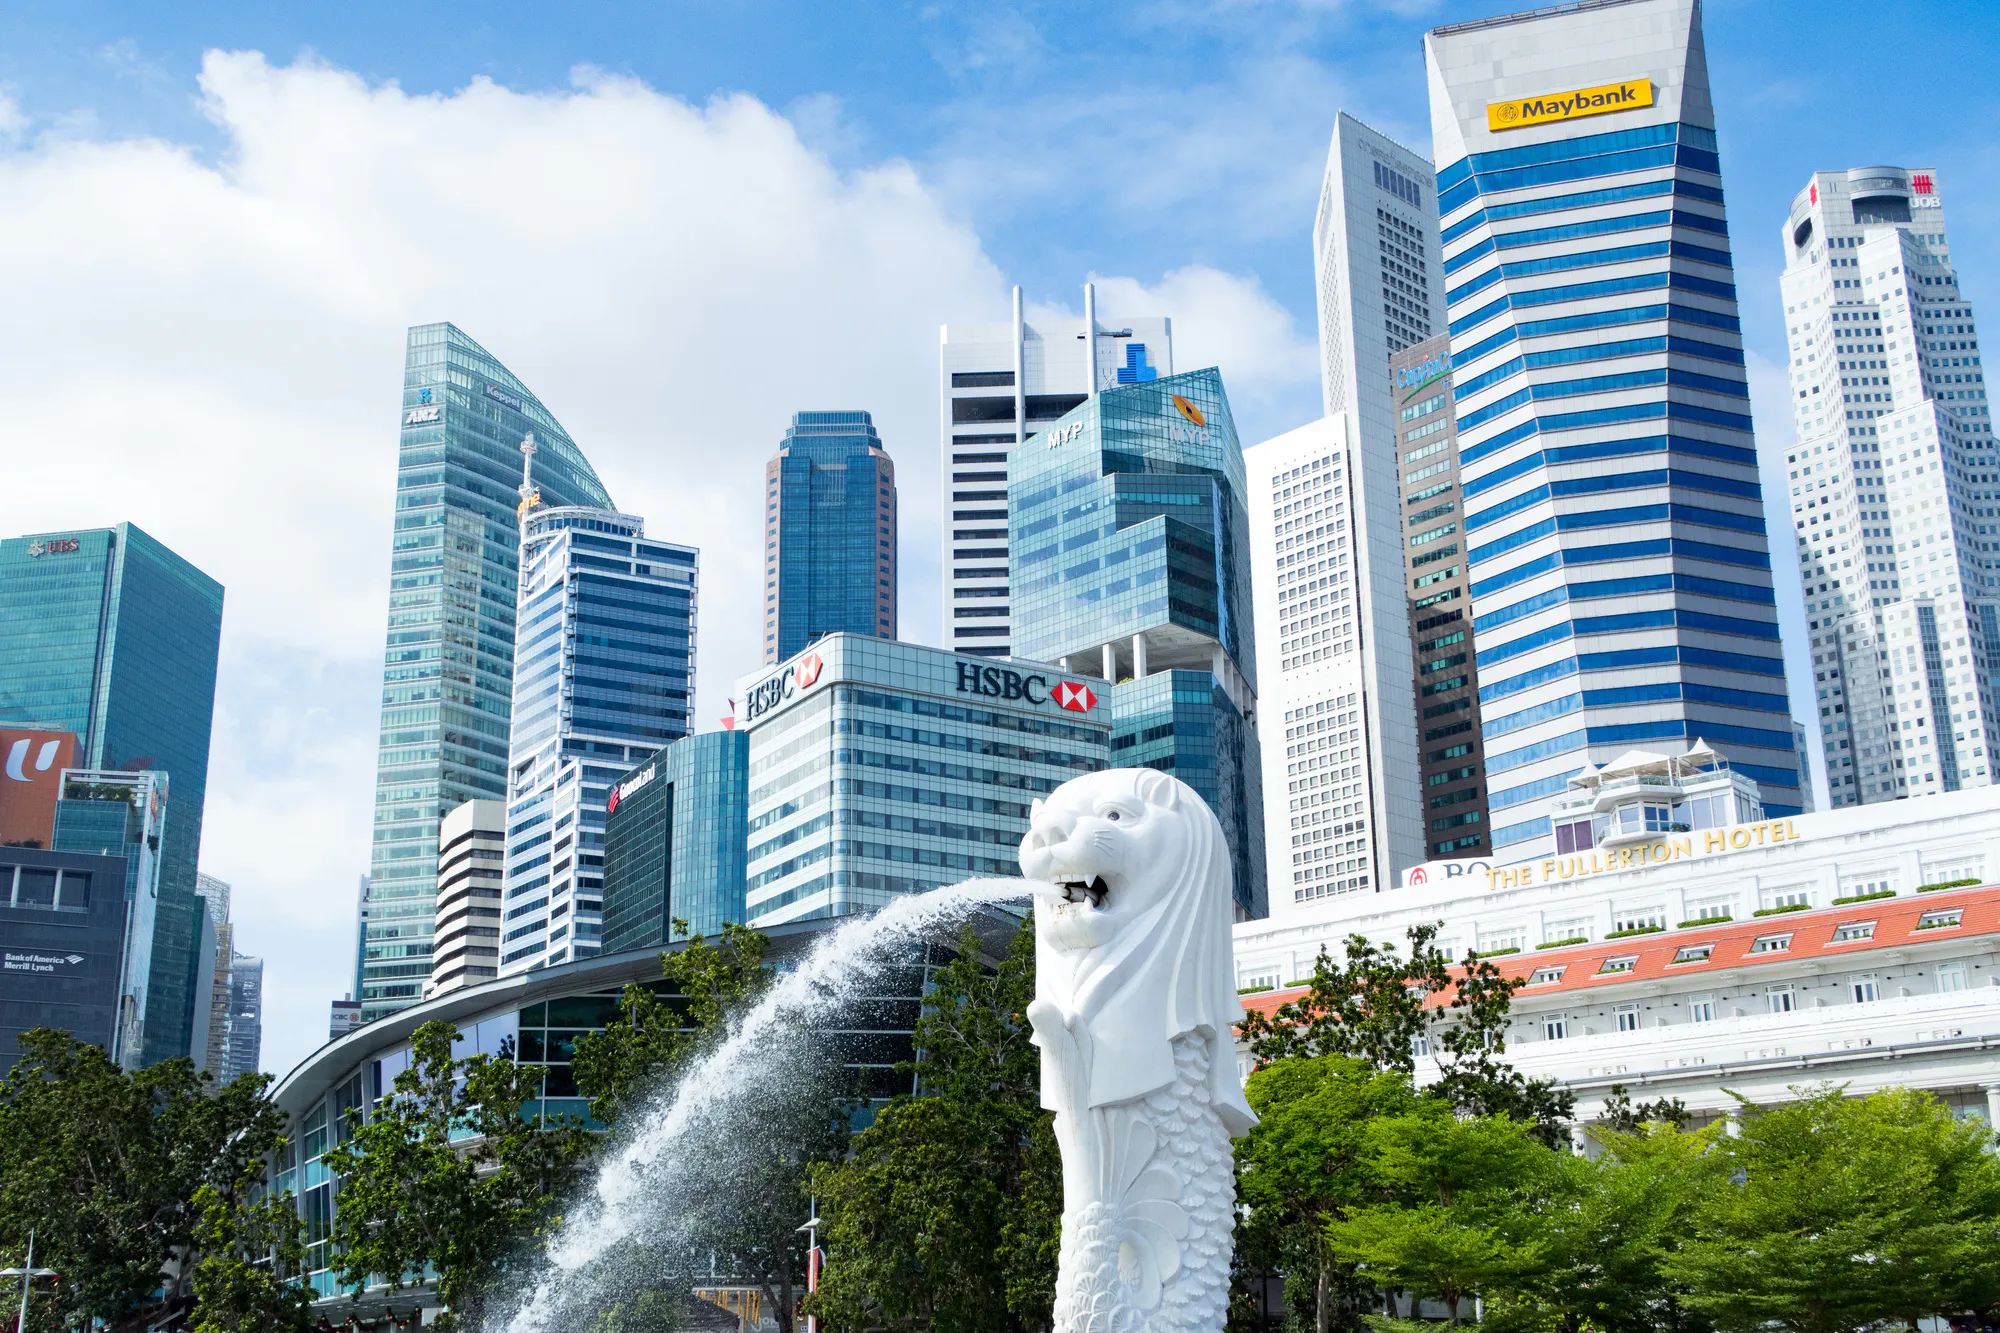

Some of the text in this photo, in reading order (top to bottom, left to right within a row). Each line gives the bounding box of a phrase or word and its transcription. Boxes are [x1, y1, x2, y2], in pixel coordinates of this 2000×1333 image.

[1522, 85, 1636, 119] Maybank
[1909, 197, 1942, 208] UOB
[486, 384, 521, 408] Keppel
[405, 408, 440, 424] ANZ
[1048, 421, 1083, 449] MYP
[1168, 423, 1210, 446] MYP
[47, 538, 79, 553] UBS
[746, 666, 795, 722] HSBC
[955, 661, 1047, 705] HSBC
[1484, 818, 1801, 891] THE FULLERTON HOTEL
[4, 961, 54, 972] Merrill Lynch
[5, 953, 25, 961] Bank
[33, 955, 65, 964] America
